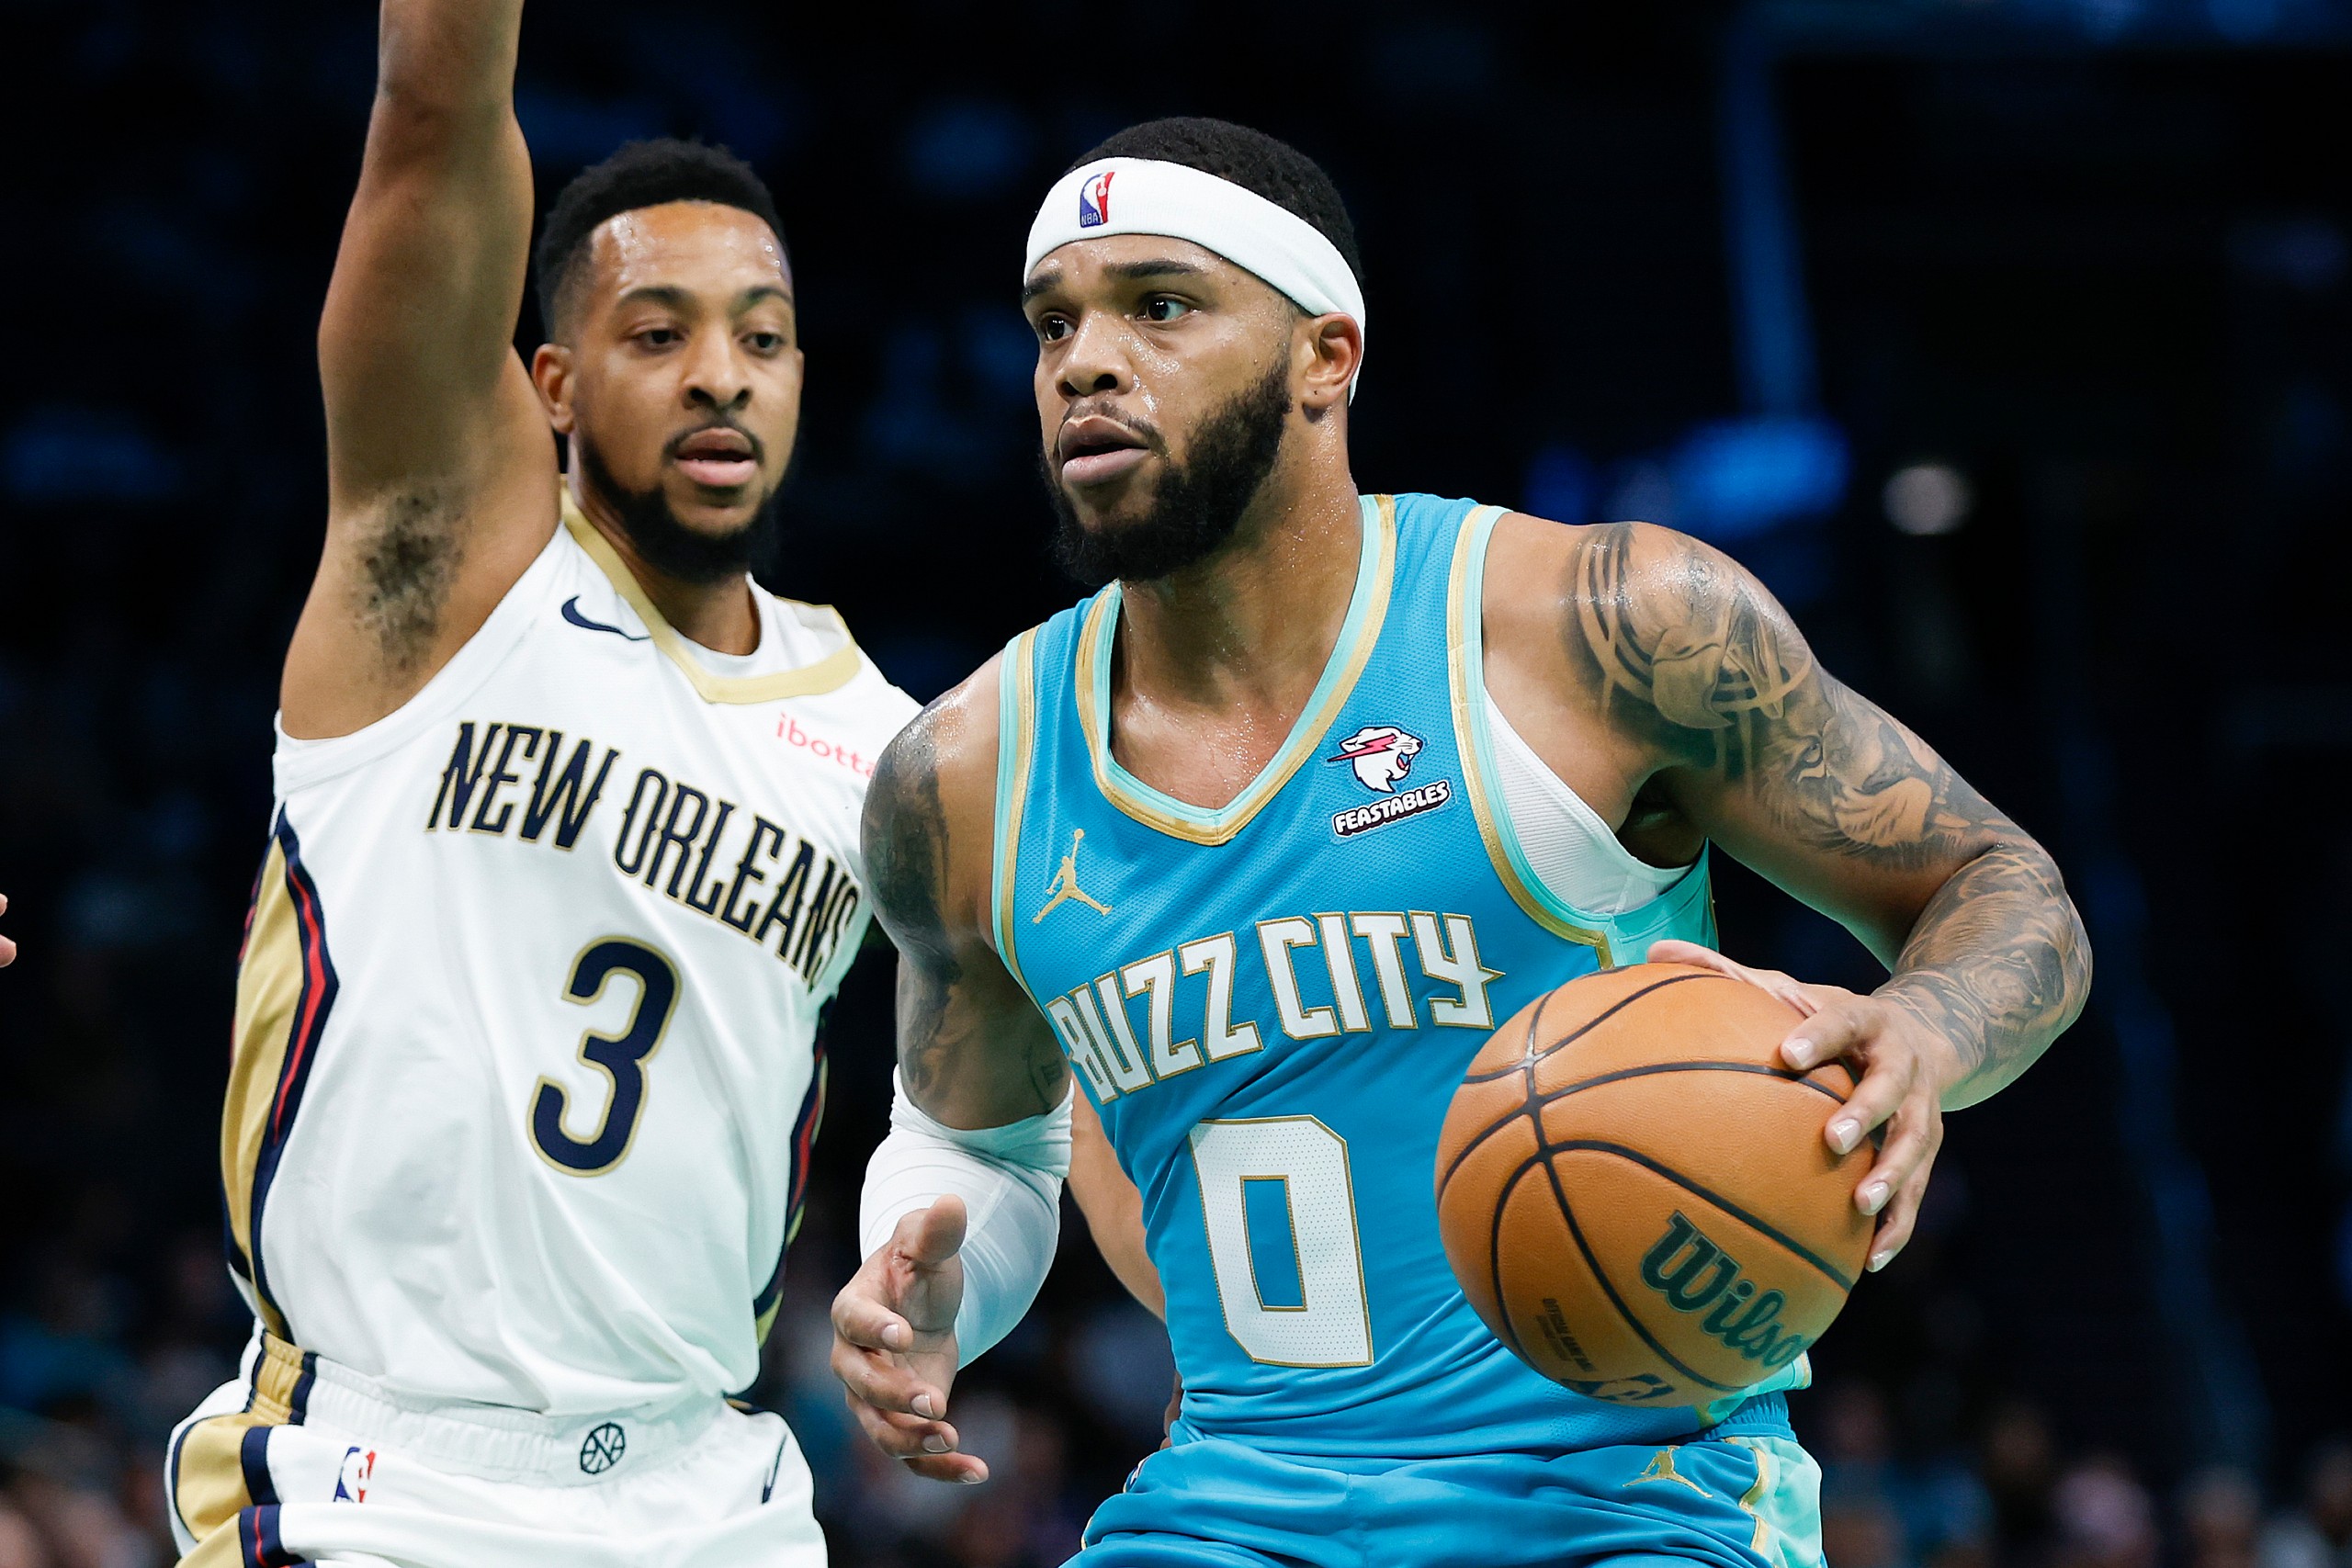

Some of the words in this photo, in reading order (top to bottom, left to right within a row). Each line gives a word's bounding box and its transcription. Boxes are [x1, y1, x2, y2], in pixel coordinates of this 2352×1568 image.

[1081, 212, 1099, 225] NBA
[425, 721, 621, 852] NEW
[614, 767, 859, 996] ORLEANS
[1334, 781, 1449, 835] FEASTABLES
[526, 935, 682, 1178] 3
[1046, 931, 1264, 1105] BUZZ
[1255, 910, 1507, 1041] CITY
[1188, 1114, 1374, 1369] 0
[1641, 1210, 1815, 1367] Wilso
